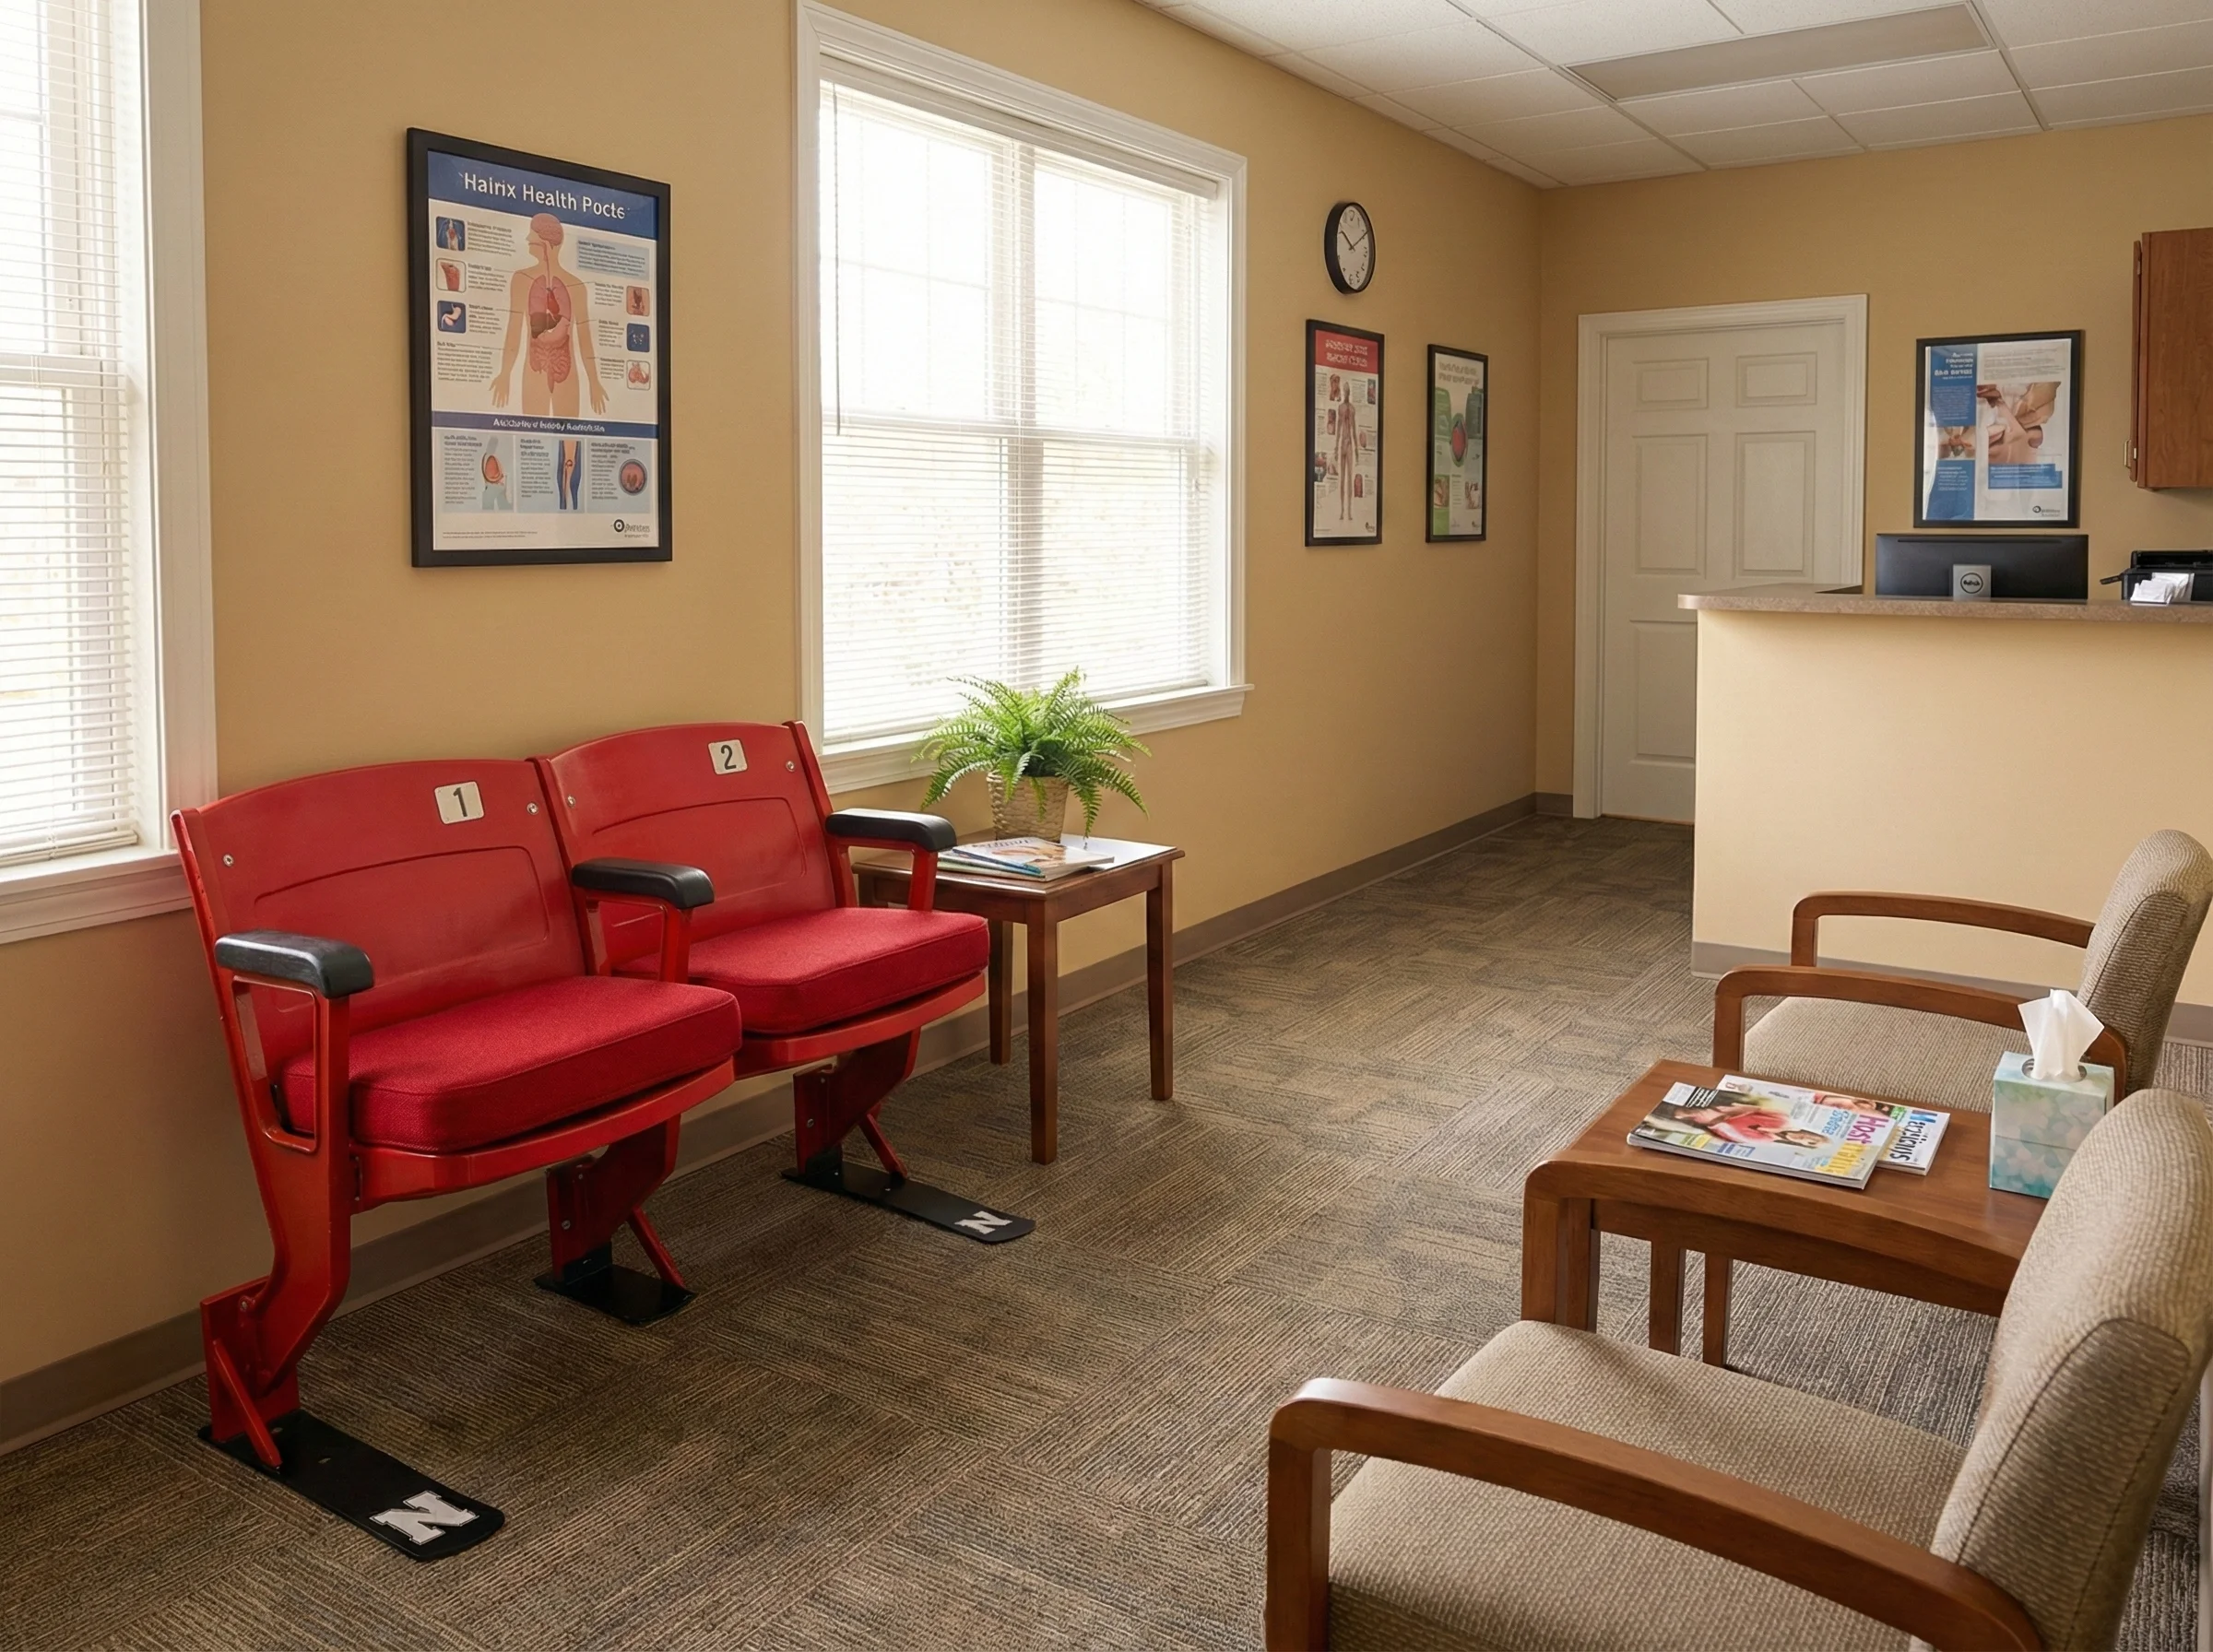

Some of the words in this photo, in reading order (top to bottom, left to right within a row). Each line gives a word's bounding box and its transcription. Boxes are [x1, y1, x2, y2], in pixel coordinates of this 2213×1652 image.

[523, 183, 577, 211] Health
[720, 744, 737, 771] 2
[453, 786, 468, 818] 1
[953, 1210, 1013, 1235] N
[369, 1490, 480, 1546] N
